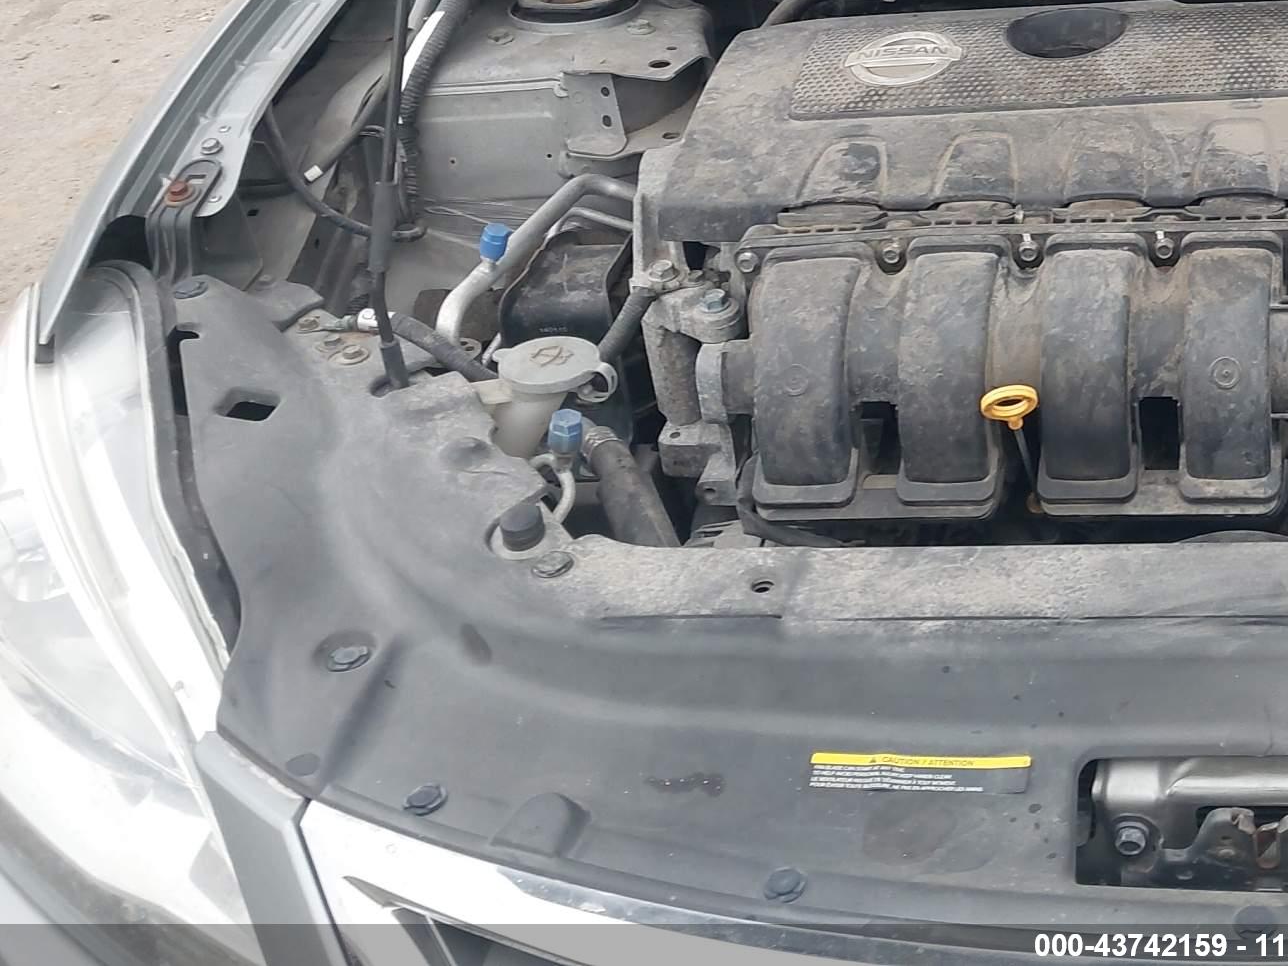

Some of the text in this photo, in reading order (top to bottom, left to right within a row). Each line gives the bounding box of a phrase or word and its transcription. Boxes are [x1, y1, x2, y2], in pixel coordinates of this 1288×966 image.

[857, 46, 949, 59] NISSAN
[881, 756, 919, 765] CAUTION
[928, 759, 974, 767] ATTENTION
